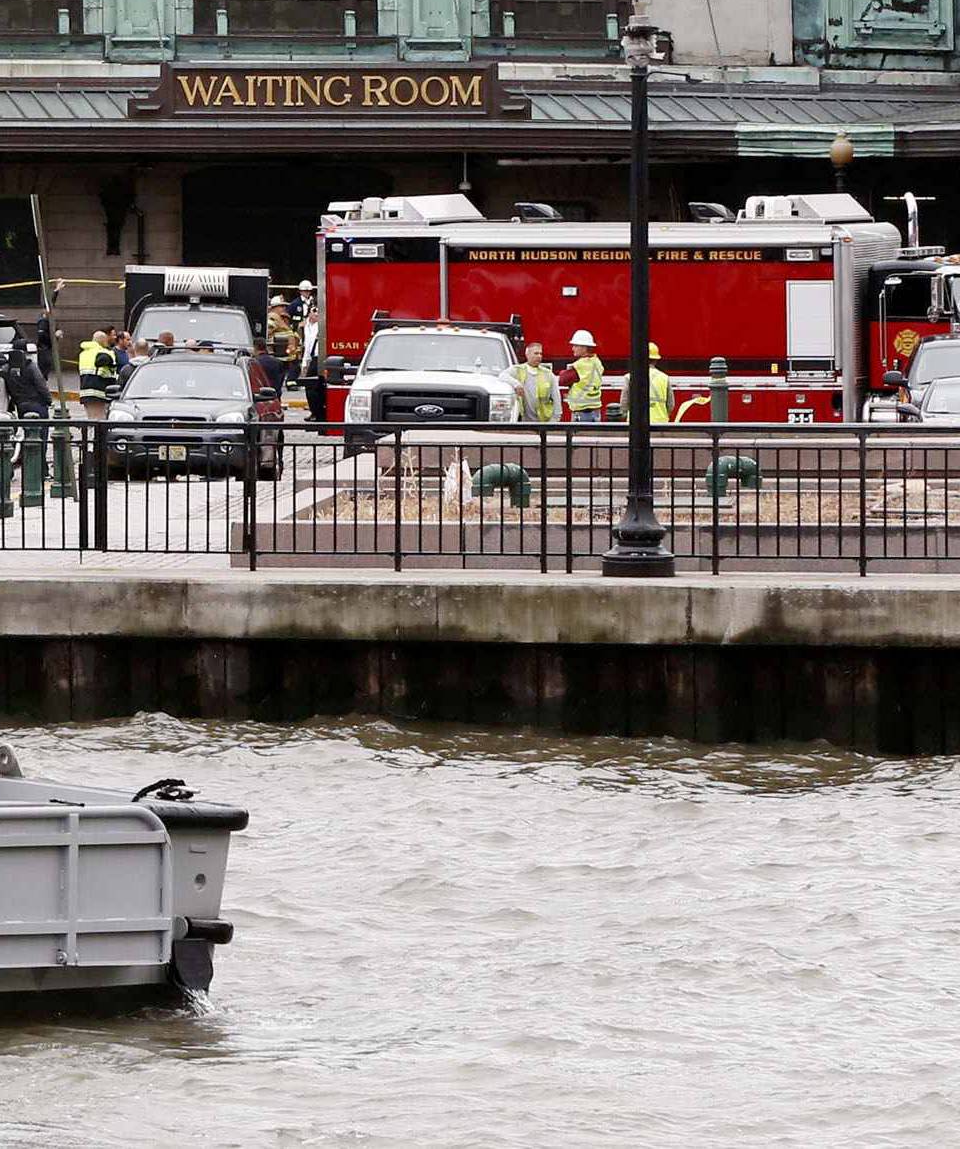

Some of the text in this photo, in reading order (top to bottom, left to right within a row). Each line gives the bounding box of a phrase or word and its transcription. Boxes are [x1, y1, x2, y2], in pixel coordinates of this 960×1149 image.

[176, 75, 483, 107] WAITING ROOM
[468, 250, 763, 261] NORTH HUDSON REGION FIRE & RESCUE
